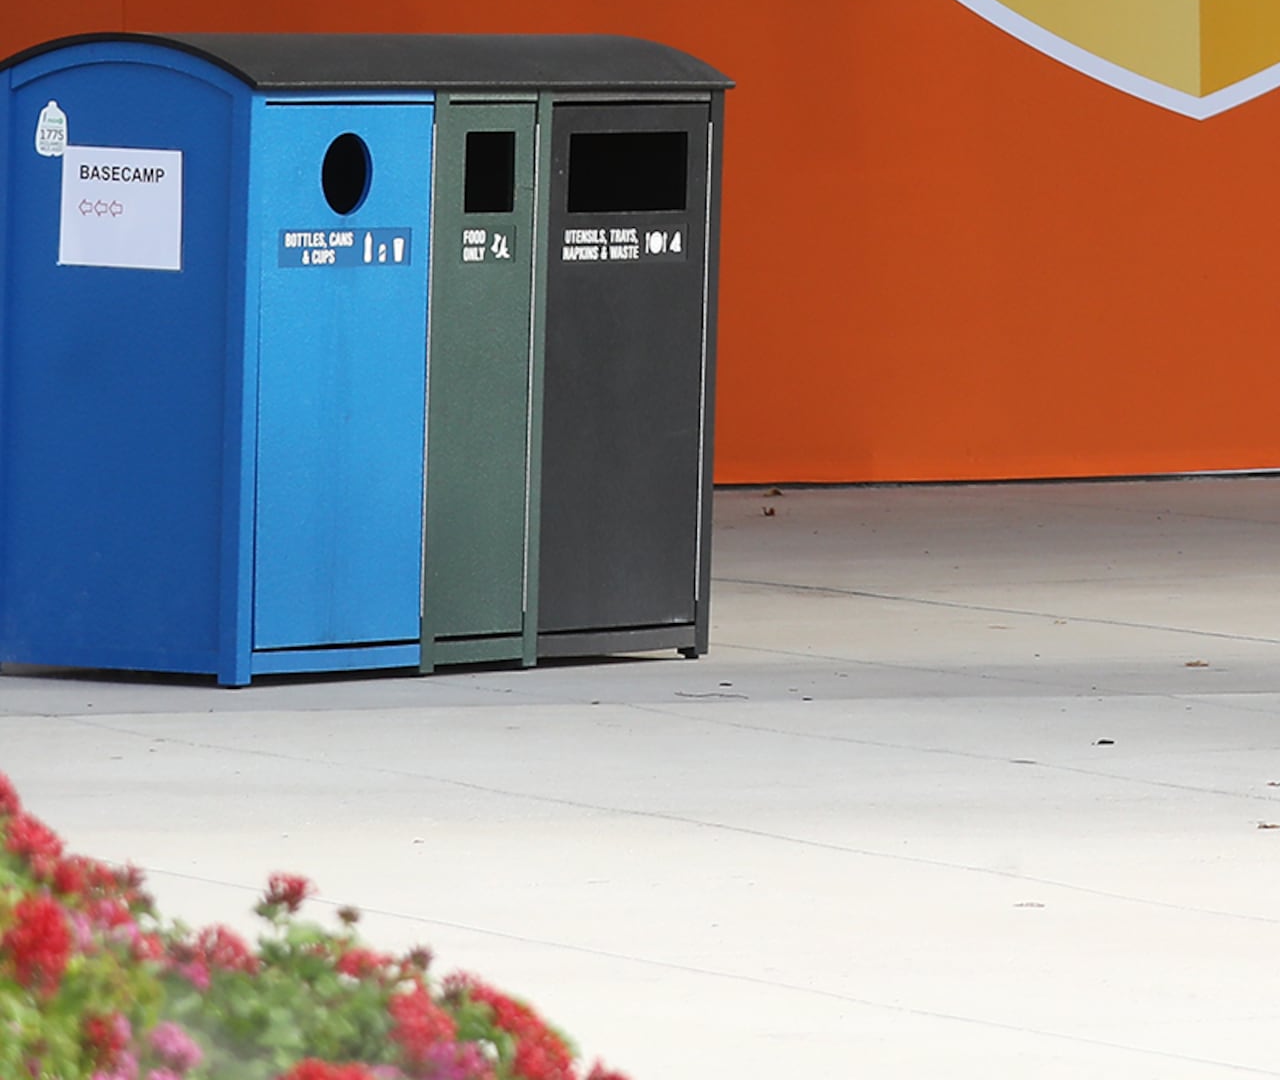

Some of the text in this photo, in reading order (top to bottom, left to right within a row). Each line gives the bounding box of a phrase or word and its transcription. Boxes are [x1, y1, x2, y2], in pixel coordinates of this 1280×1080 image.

[79, 165, 165, 183] BASECAMP
[285, 231, 354, 248] BOTTLES, CANS
[463, 229, 487, 244] FOOD
[565, 229, 608, 245] UTENSILS,
[302, 249, 336, 264] & CUPS
[463, 246, 486, 261] ONLY
[562, 245, 599, 260] NAPKINS
[609, 245, 639, 260] WASTE
